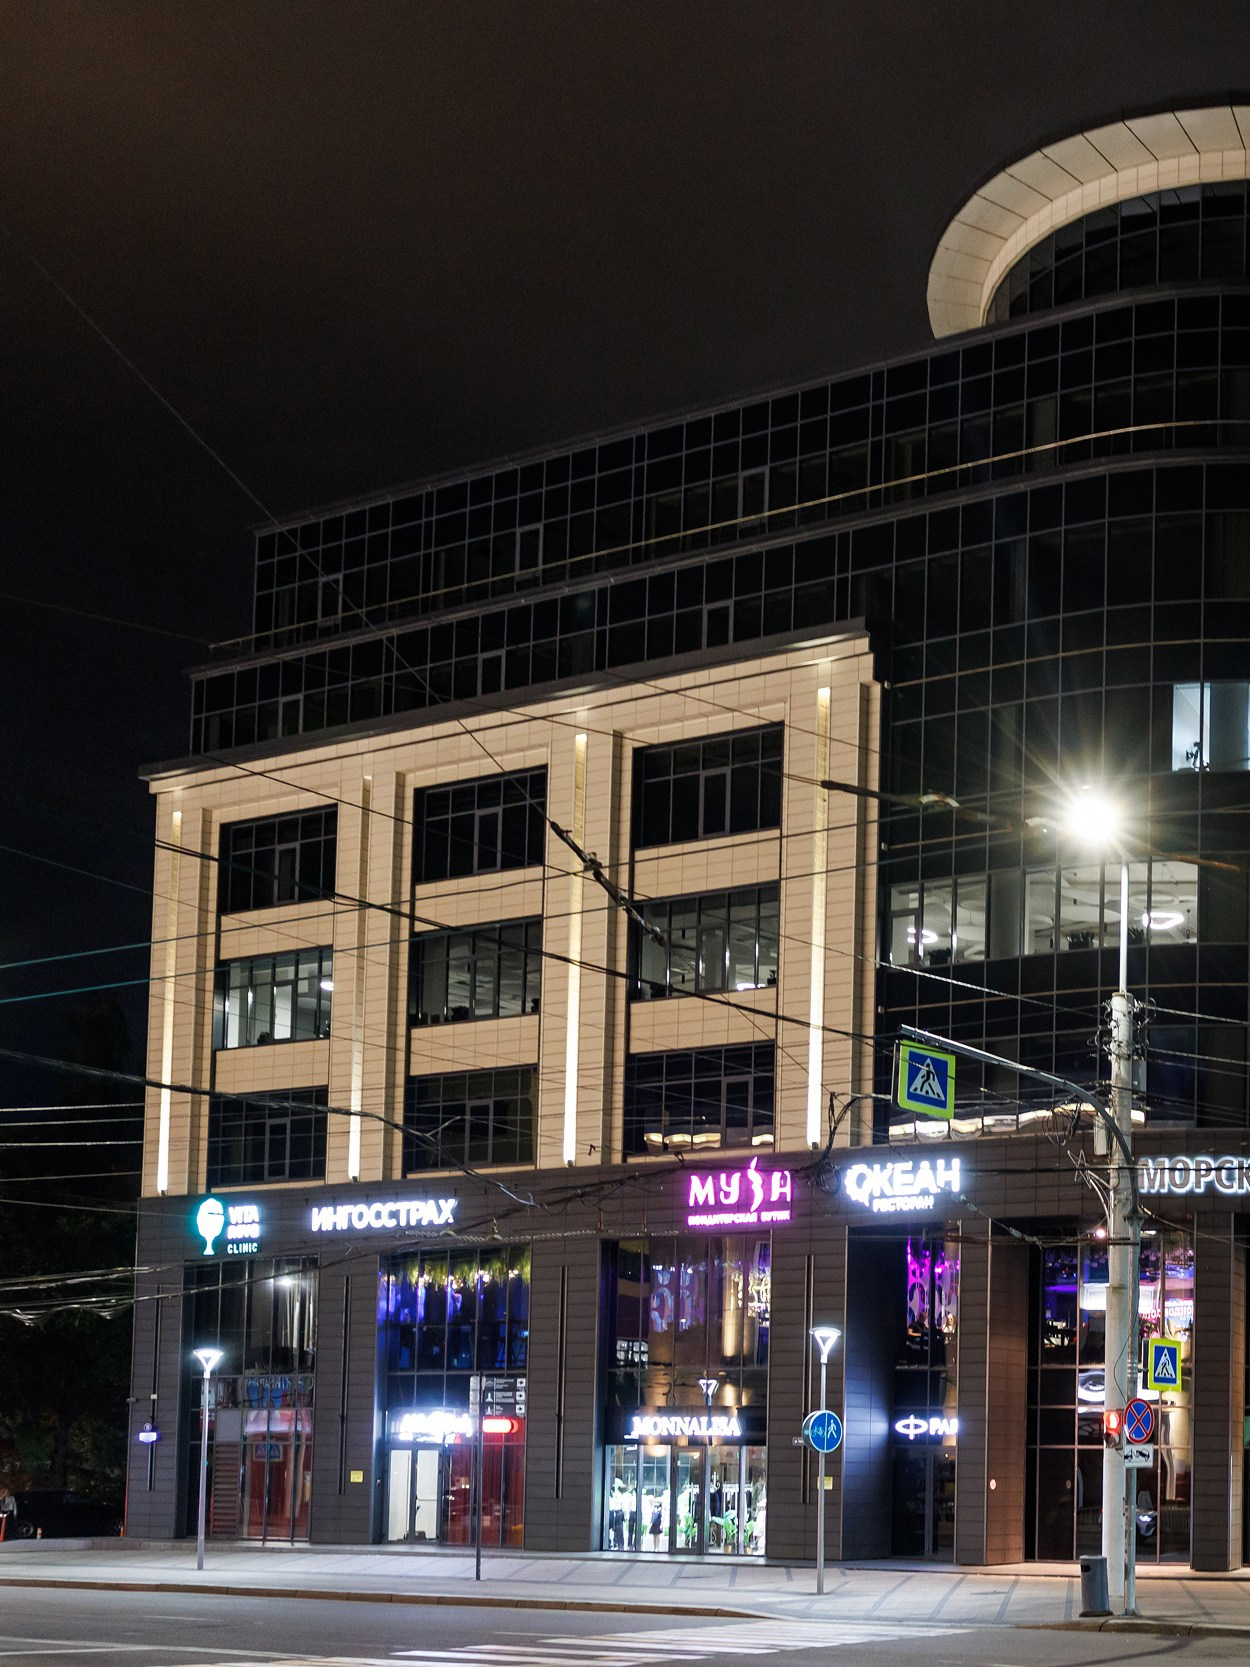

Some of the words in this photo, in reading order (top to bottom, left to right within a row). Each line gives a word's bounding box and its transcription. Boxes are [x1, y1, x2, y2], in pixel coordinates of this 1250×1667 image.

[844, 1157, 961, 1207] ОКЕАН
[311, 1198, 458, 1232] ИНГОССТРАХ
[226, 1242, 258, 1255] CLINIC
